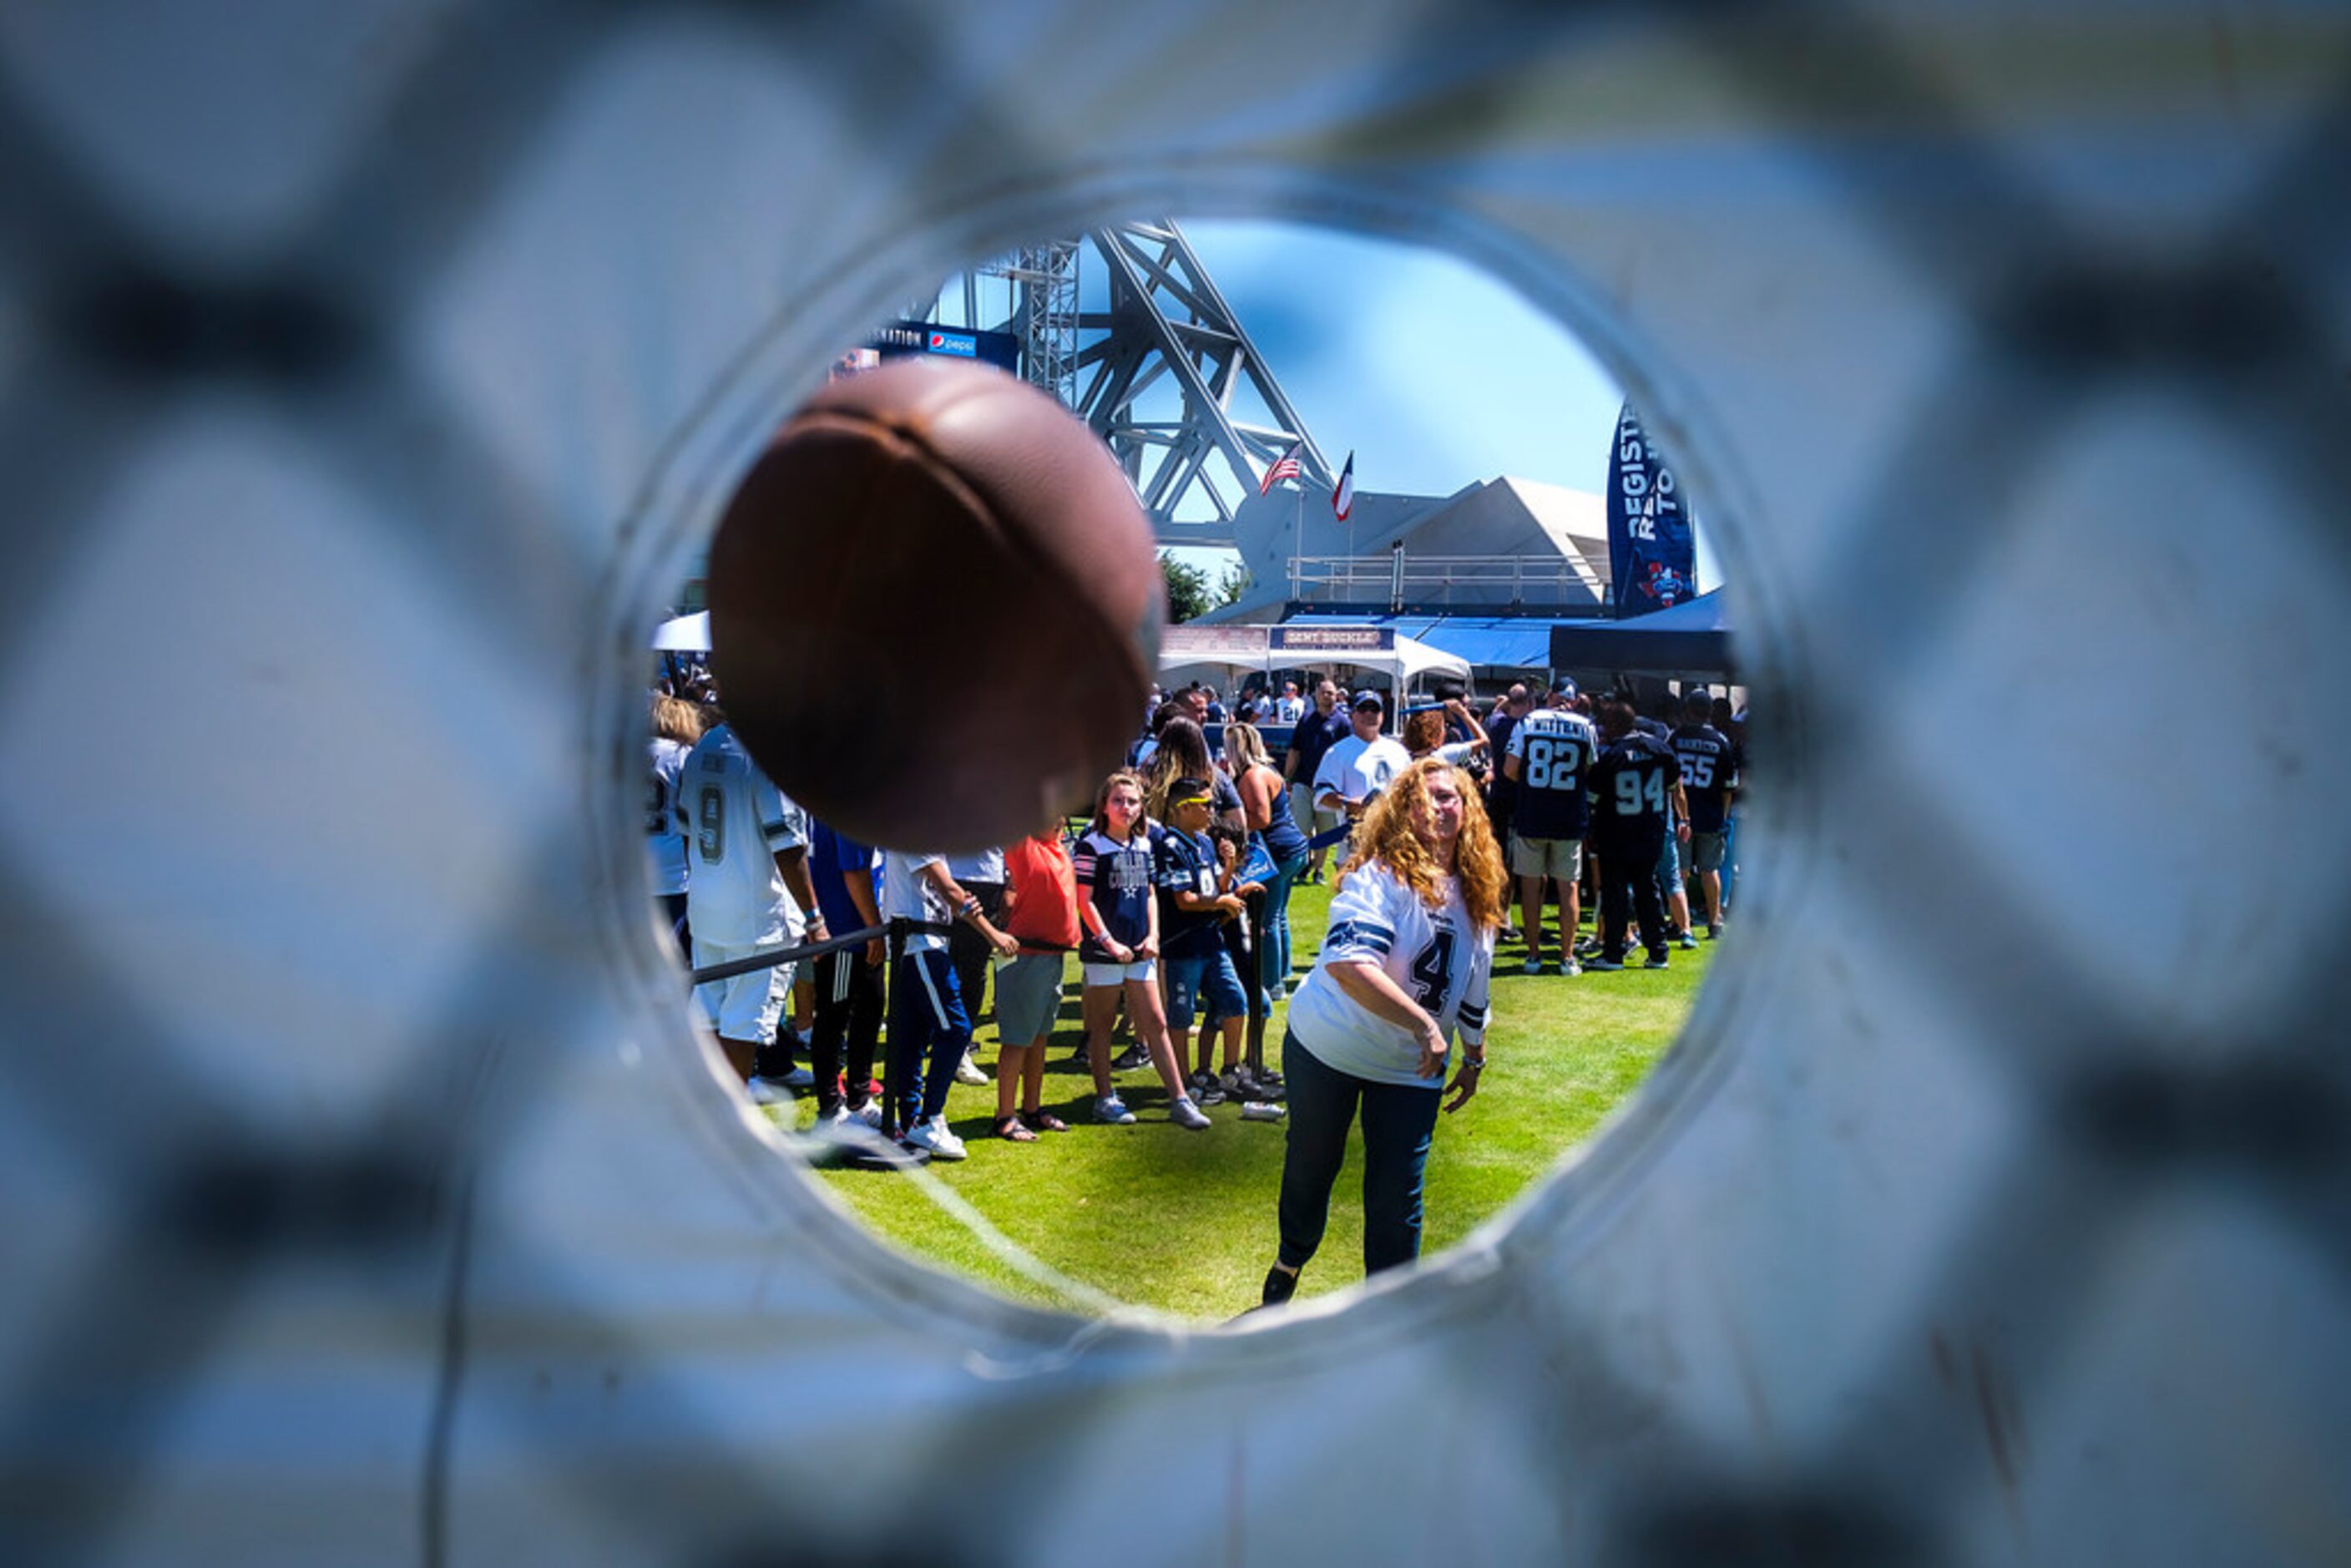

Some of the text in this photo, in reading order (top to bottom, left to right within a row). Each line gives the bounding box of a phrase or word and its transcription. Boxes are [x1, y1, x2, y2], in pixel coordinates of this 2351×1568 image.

[944, 340, 974, 351] pepsi
[1527, 738, 1579, 790] 82
[1677, 753, 1716, 788] 55
[1615, 768, 1664, 815] 94
[1410, 926, 1459, 1017] 4
